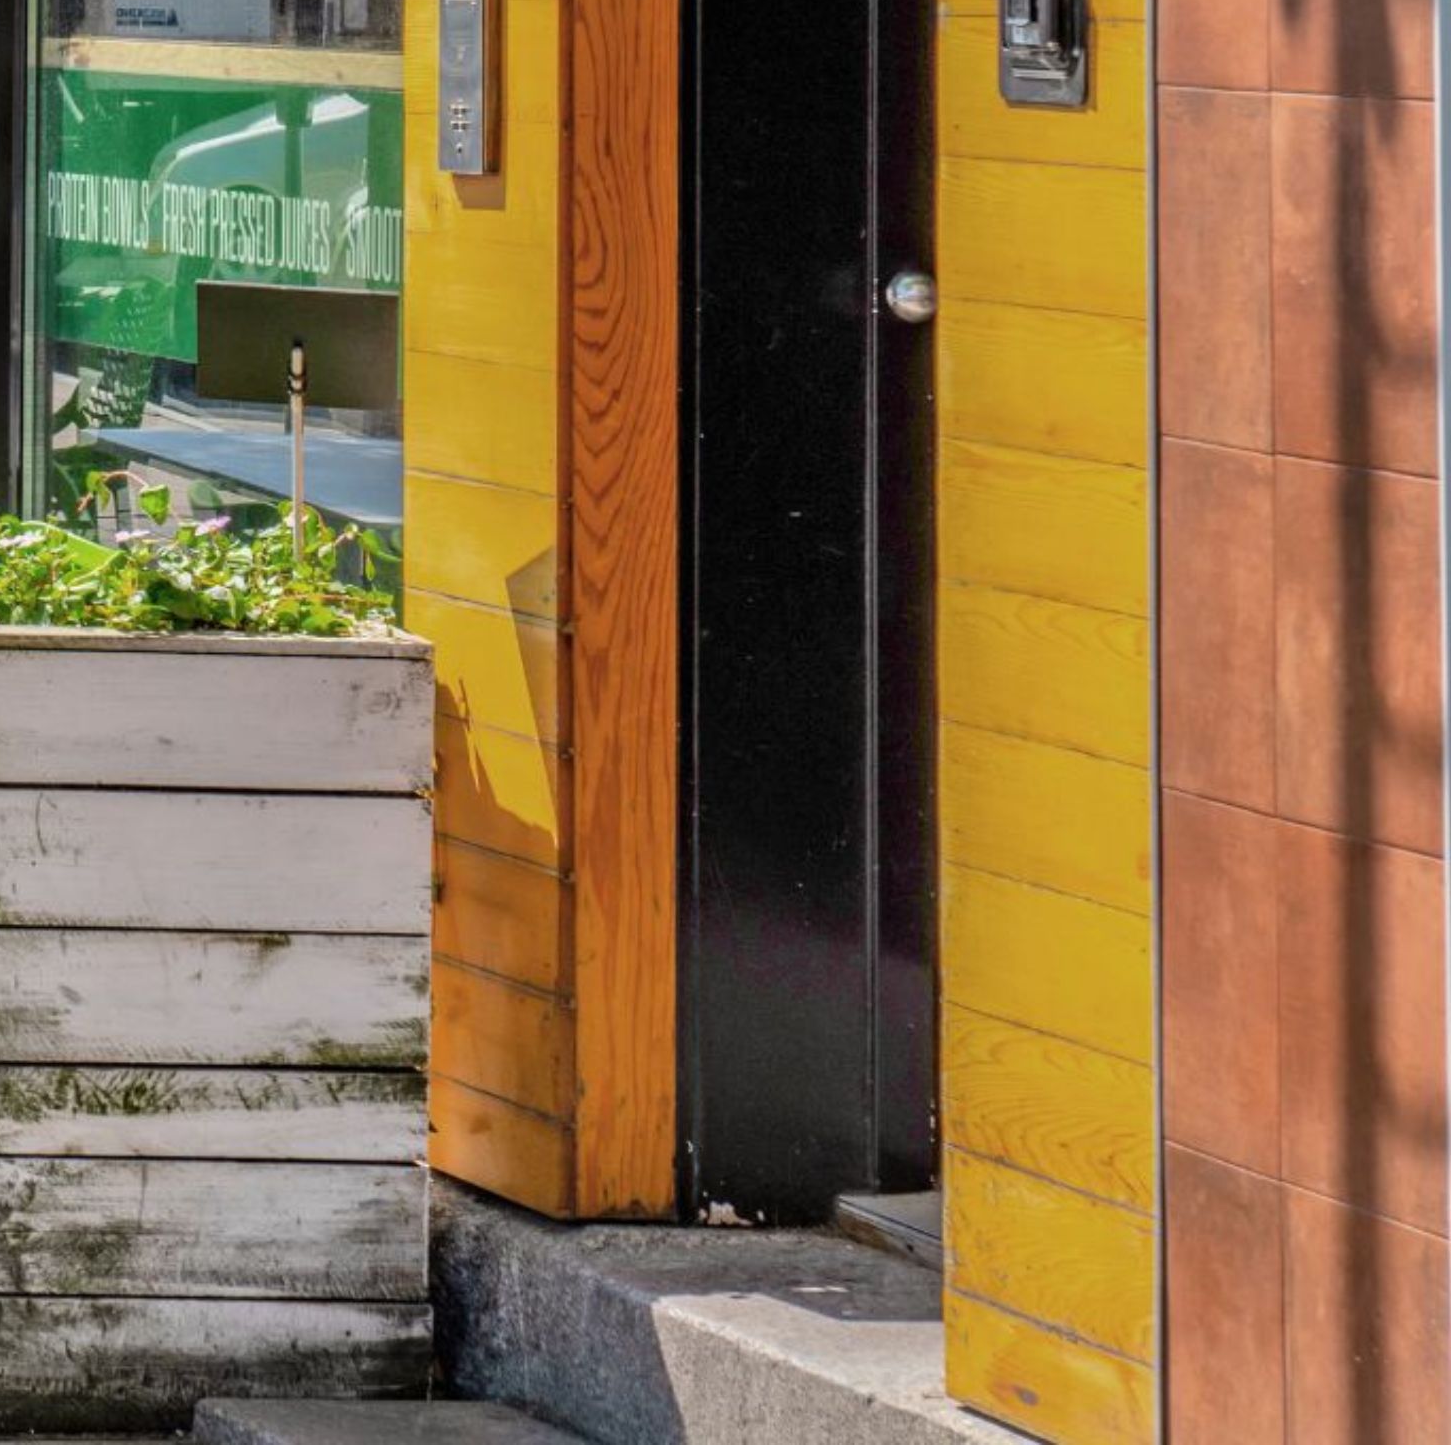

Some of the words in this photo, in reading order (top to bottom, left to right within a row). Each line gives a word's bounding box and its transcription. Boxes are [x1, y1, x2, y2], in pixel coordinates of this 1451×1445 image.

[48, 171, 99, 243] PROTEIN
[103, 174, 149, 249] BOWLS
[163, 181, 206, 258] FRESH
[210, 188, 276, 267] PRESSED
[278, 196, 331, 275] JUICES
[345, 205, 402, 284] SMOOT
